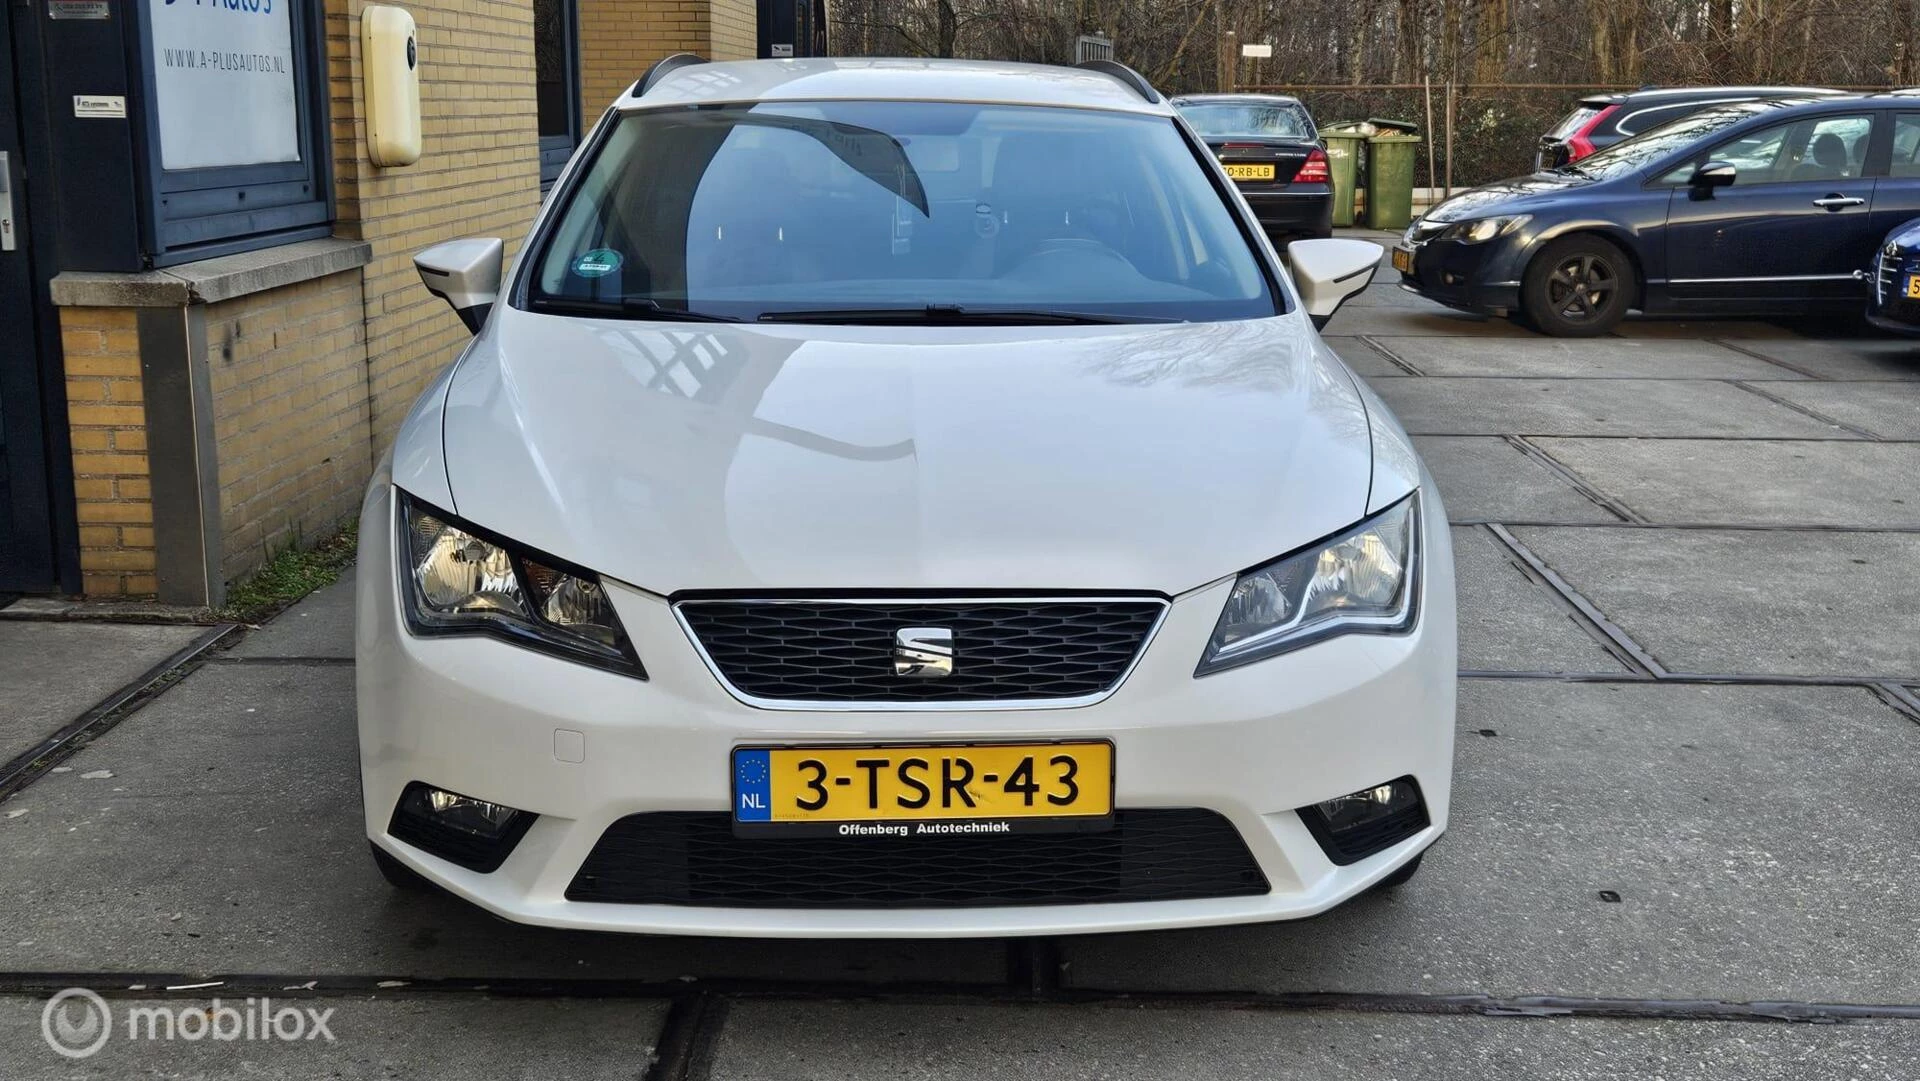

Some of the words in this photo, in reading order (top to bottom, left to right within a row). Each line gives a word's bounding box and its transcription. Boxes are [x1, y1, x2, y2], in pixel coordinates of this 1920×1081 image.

[164, 48, 285, 74] WWW.A-PLUSAUTOS.NL
[1223, 167, 1270, 177] 0-RB-LB
[795, 755, 1080, 811] 3-TSR-43
[742, 793, 767, 809] NL
[839, 824, 909, 836] Offenberg
[916, 821, 1010, 834] Autotechniek
